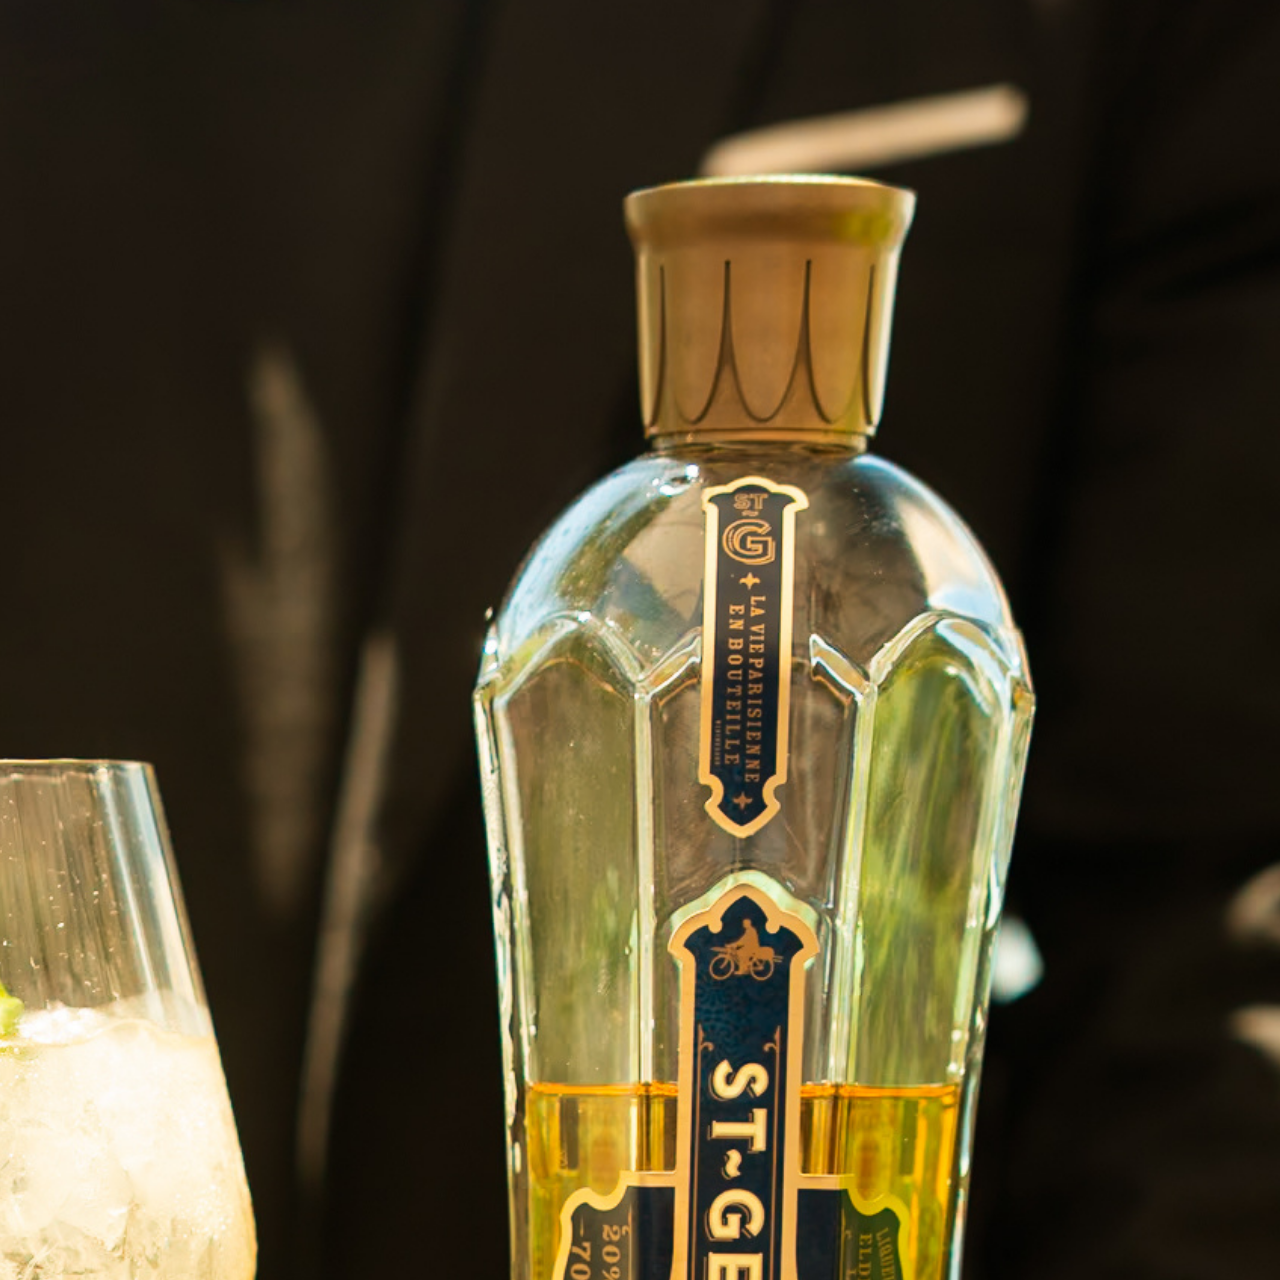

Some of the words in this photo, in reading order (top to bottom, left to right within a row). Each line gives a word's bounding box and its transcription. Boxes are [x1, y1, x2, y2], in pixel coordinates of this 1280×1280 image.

[733, 493, 769, 510] ST
[722, 519, 776, 566] G
[728, 604, 745, 630] EN
[749, 595, 766, 617] LA
[724, 637, 744, 765] BOUTEILLE
[745, 657, 765, 783] PARISIENNE
